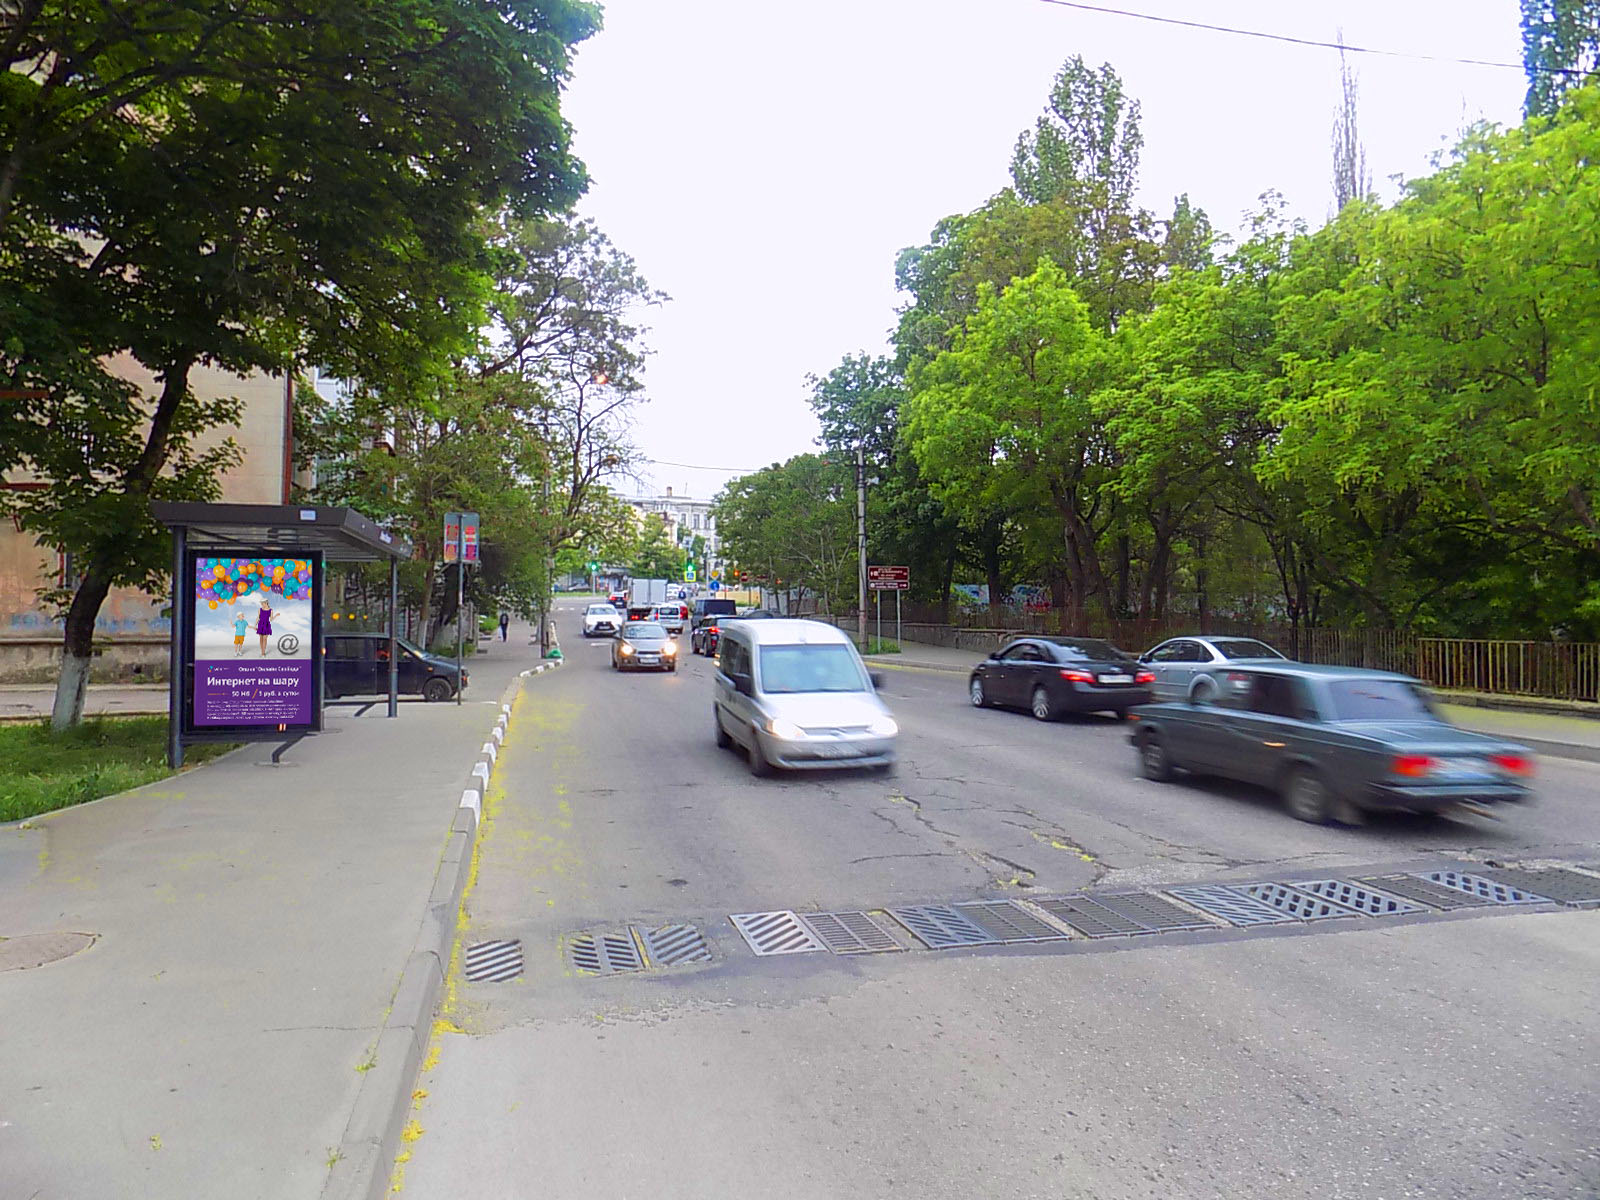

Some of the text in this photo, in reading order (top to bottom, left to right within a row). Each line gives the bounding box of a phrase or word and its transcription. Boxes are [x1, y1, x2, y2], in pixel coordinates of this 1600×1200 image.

[207, 676, 300, 688] Интернет на шару
